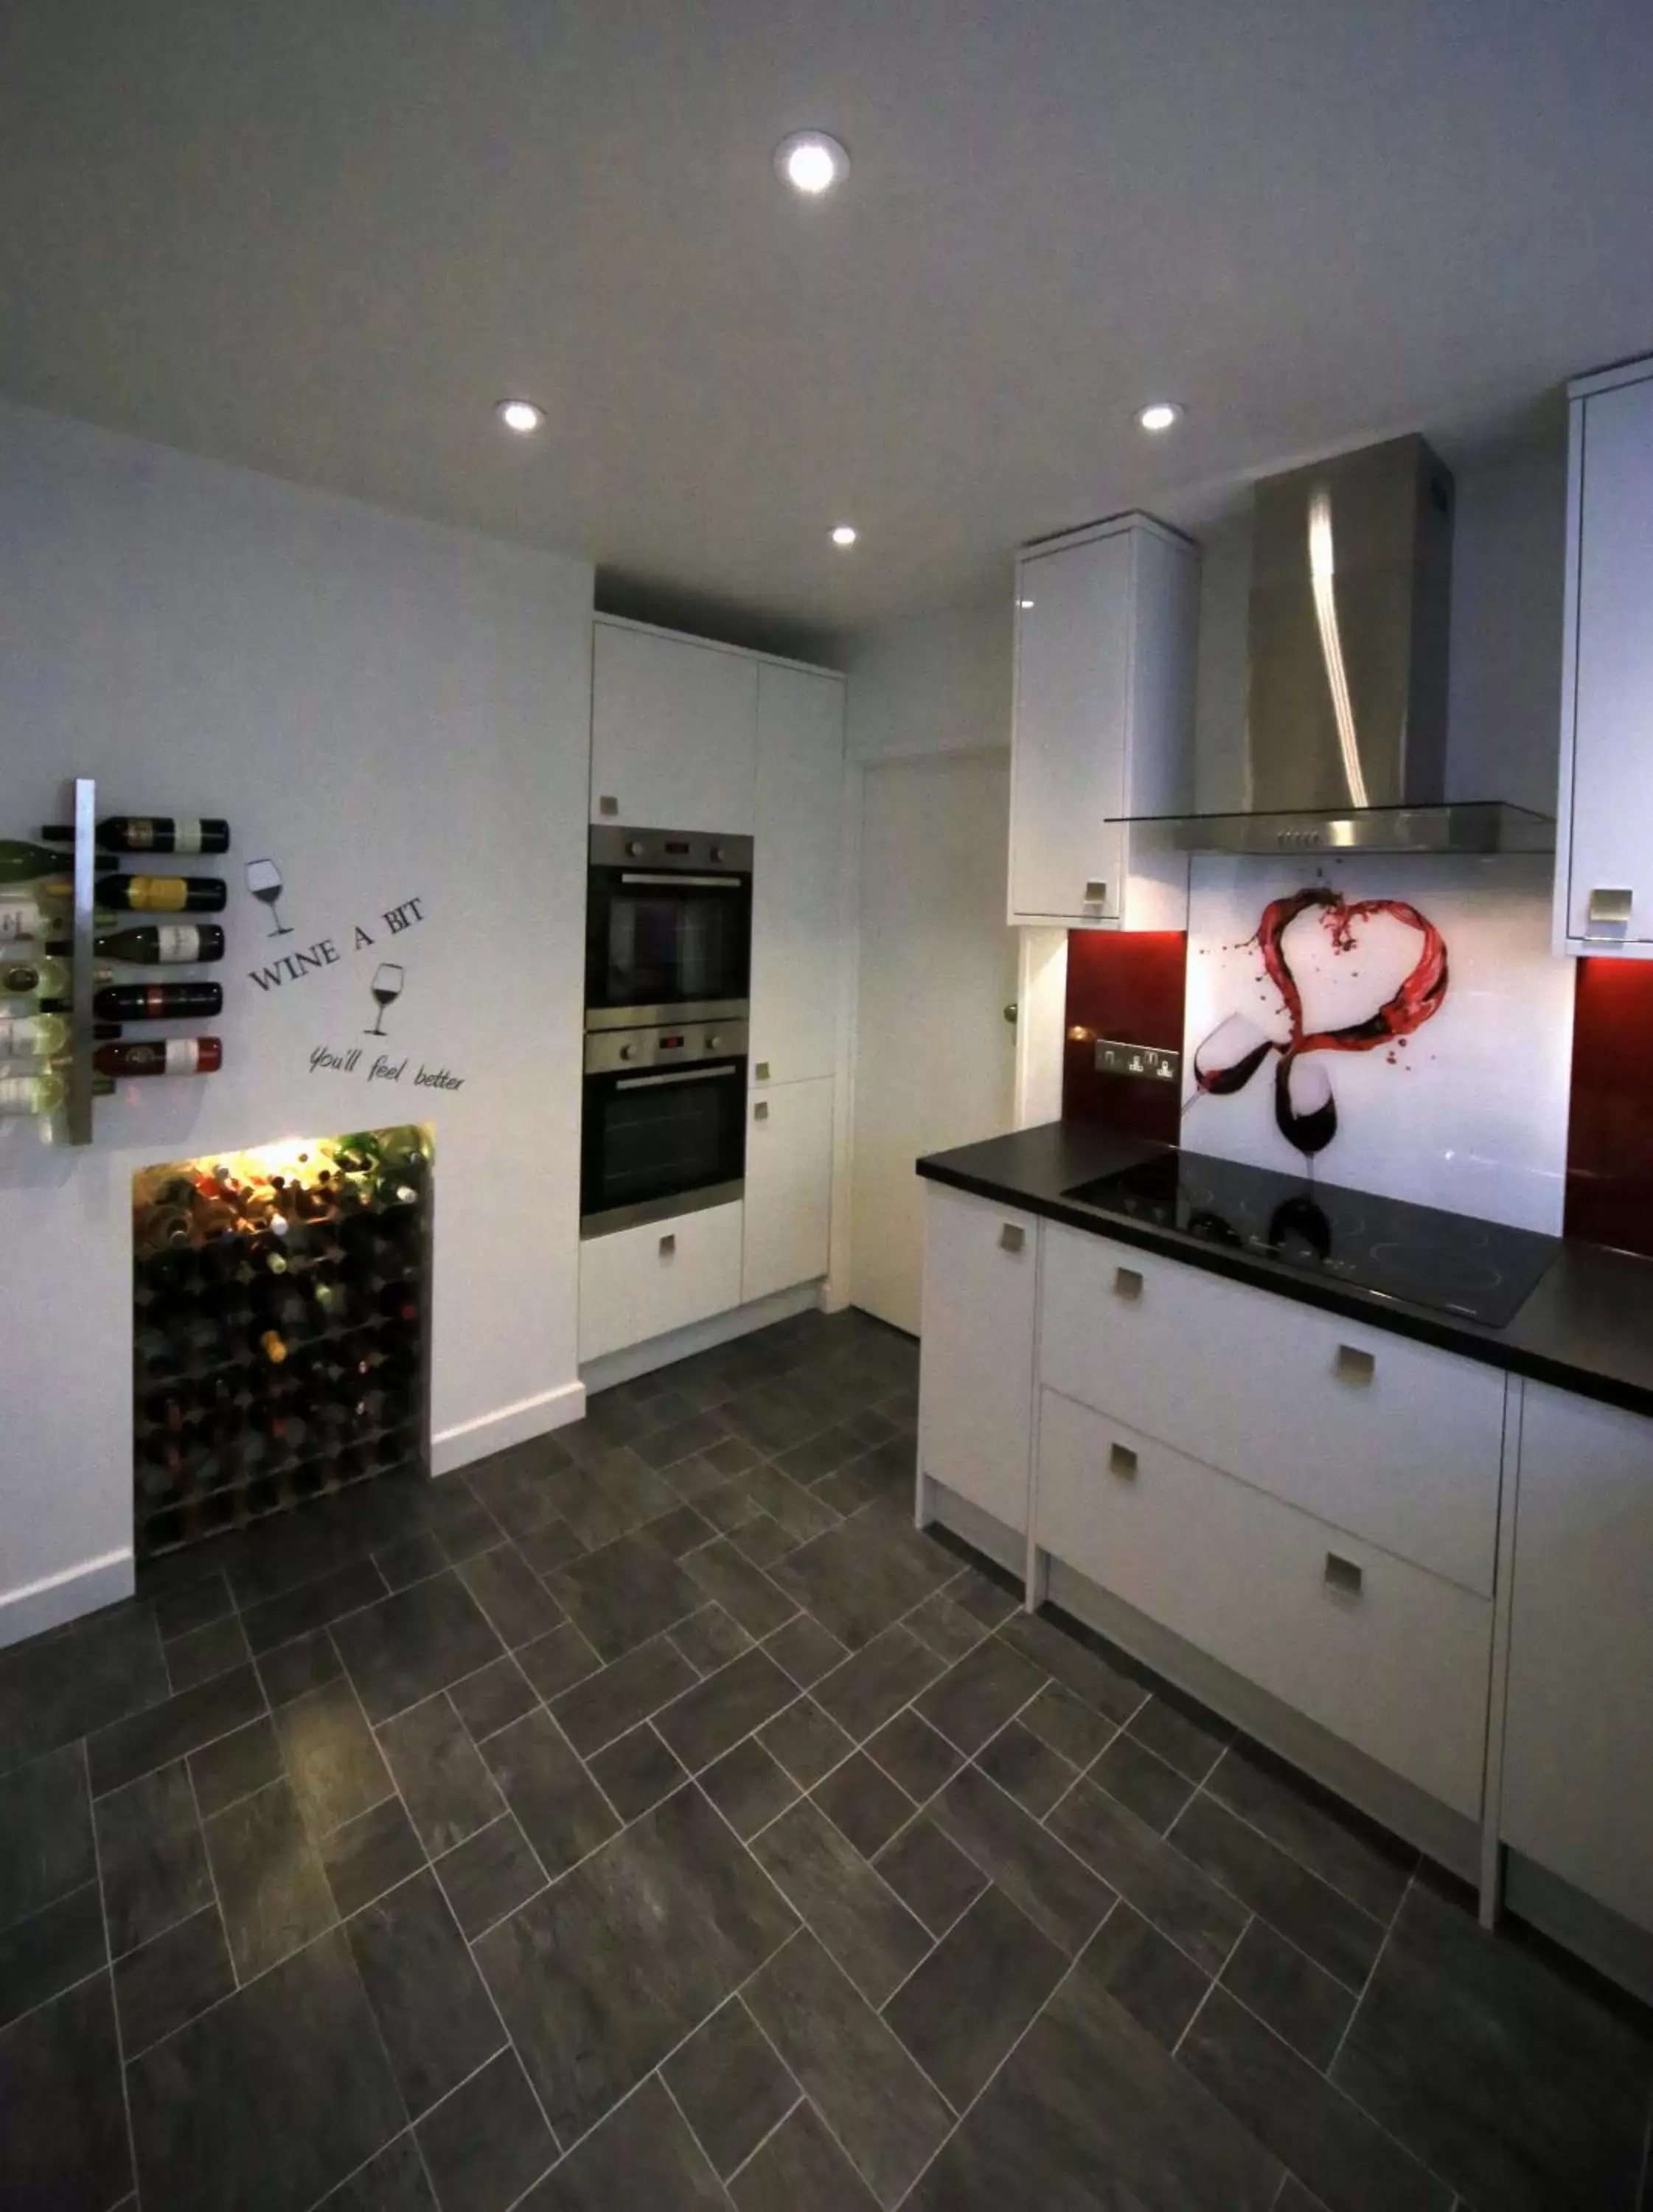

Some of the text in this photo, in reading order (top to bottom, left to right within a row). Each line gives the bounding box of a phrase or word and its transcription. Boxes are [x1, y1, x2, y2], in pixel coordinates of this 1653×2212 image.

[248, 897, 424, 991] WINE A BIT
[367, 1055, 407, 1082] feel
[413, 1065, 464, 1091] better
